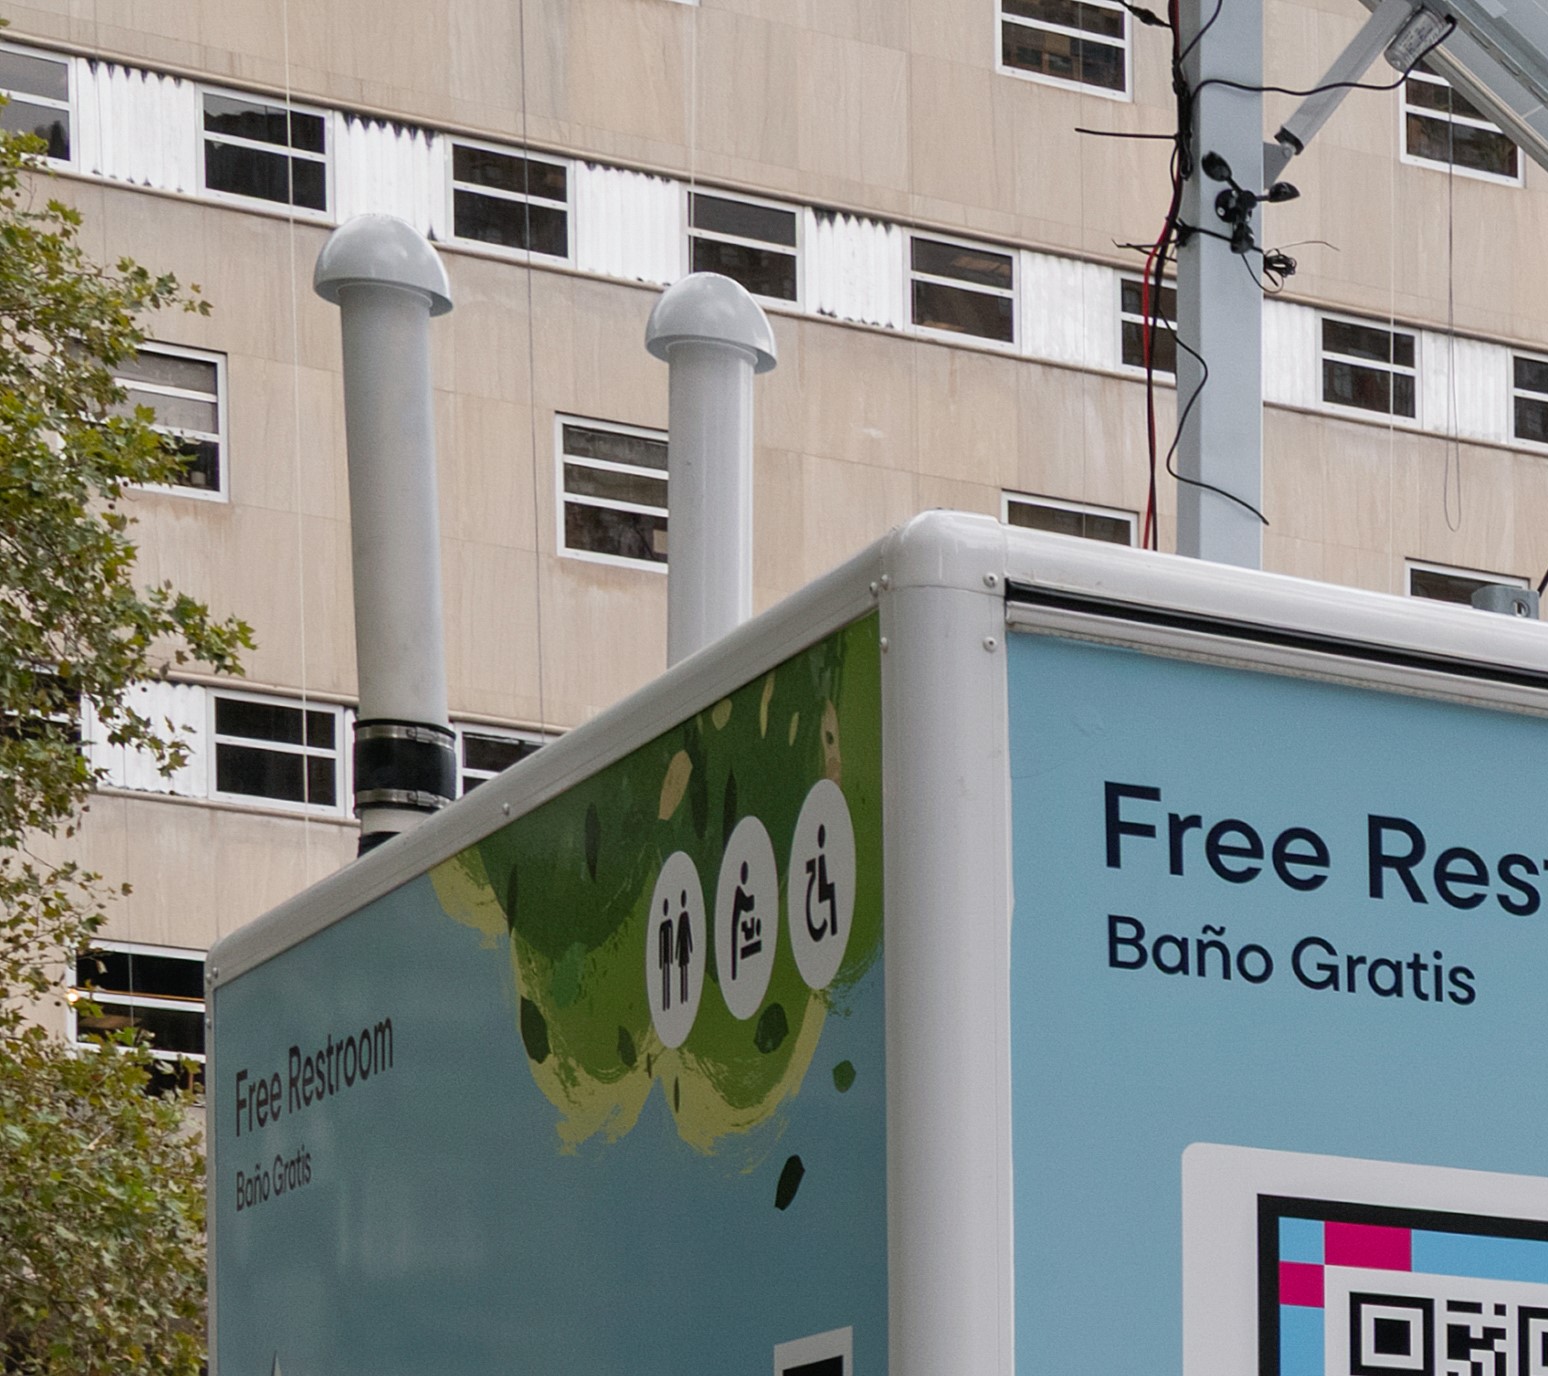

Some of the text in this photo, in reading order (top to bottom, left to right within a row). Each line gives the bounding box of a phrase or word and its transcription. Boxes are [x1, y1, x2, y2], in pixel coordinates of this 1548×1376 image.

[1104, 781, 1330, 892] Free
[1107, 914, 1477, 1006] Baño Gratis
[235, 1016, 394, 1138] Free Restroom
[236, 1144, 312, 1212] Baño Gratis
